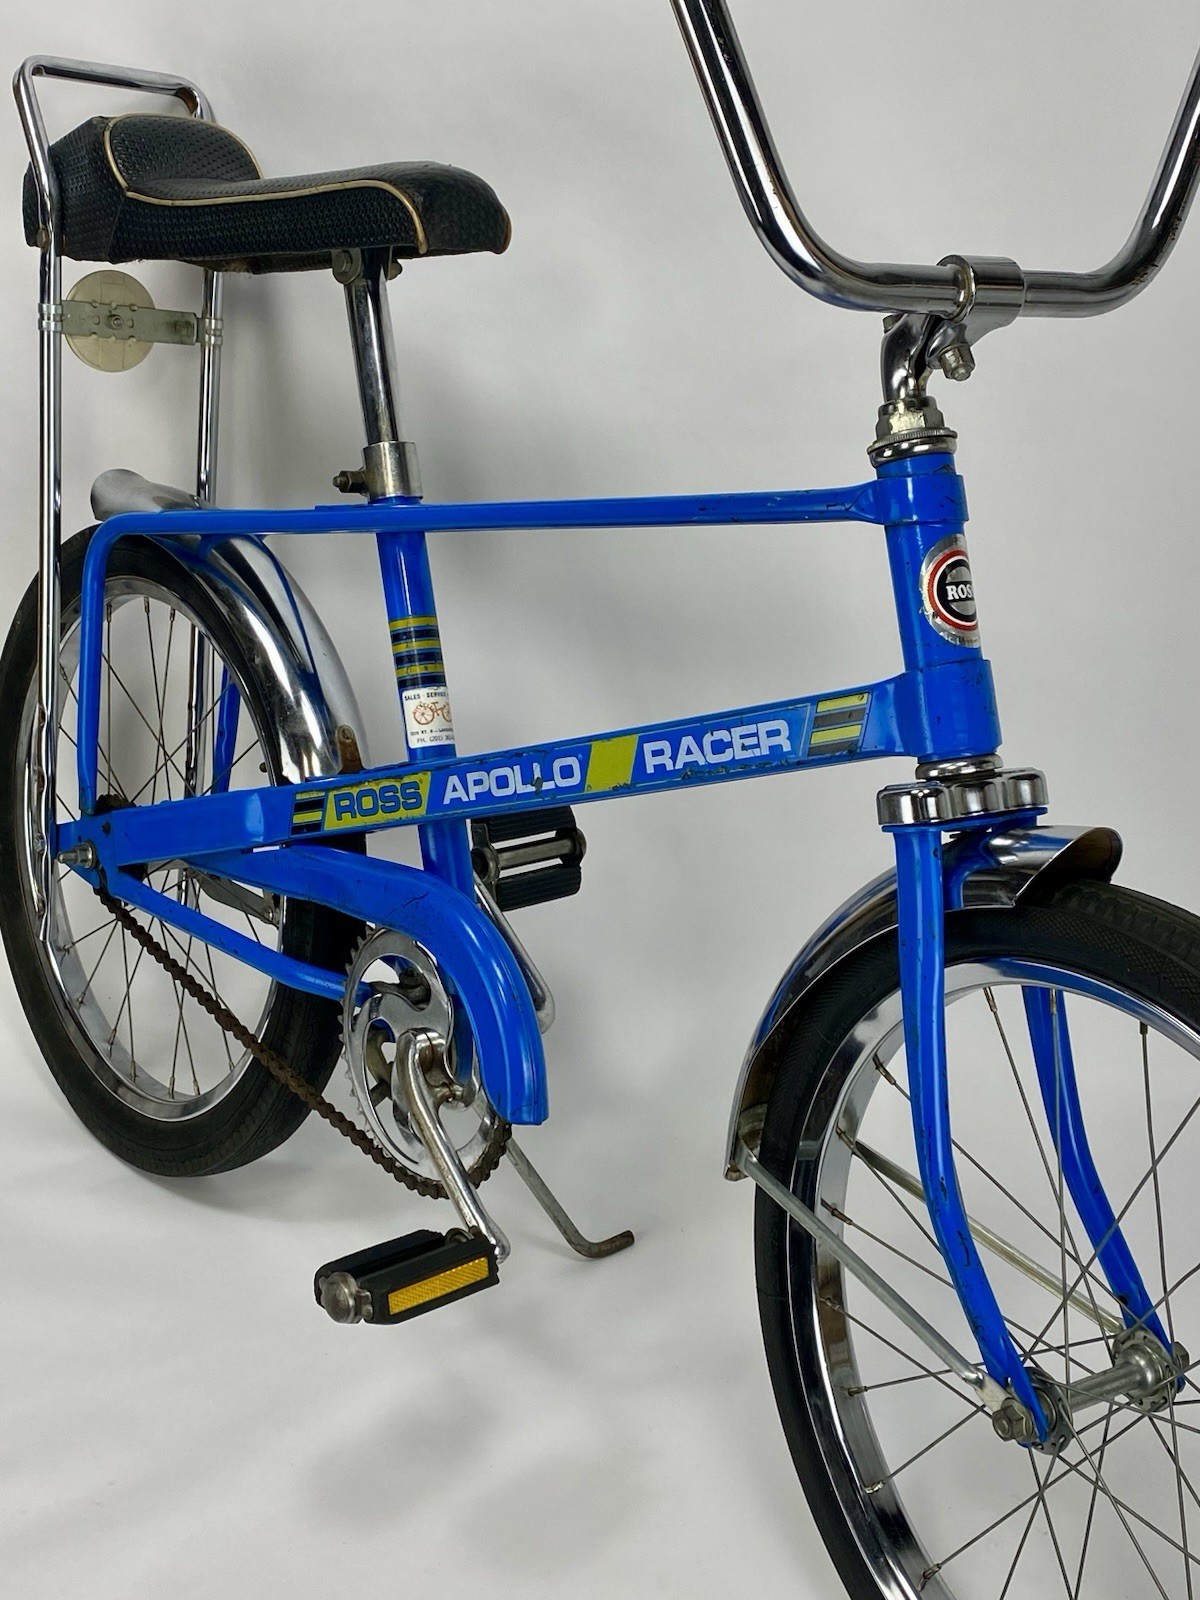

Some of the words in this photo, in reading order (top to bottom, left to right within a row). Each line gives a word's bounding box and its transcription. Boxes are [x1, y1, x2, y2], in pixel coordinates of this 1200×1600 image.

[333, 780, 423, 821] ROSS
[442, 756, 582, 805] APOLLO
[643, 719, 792, 774] RACER
